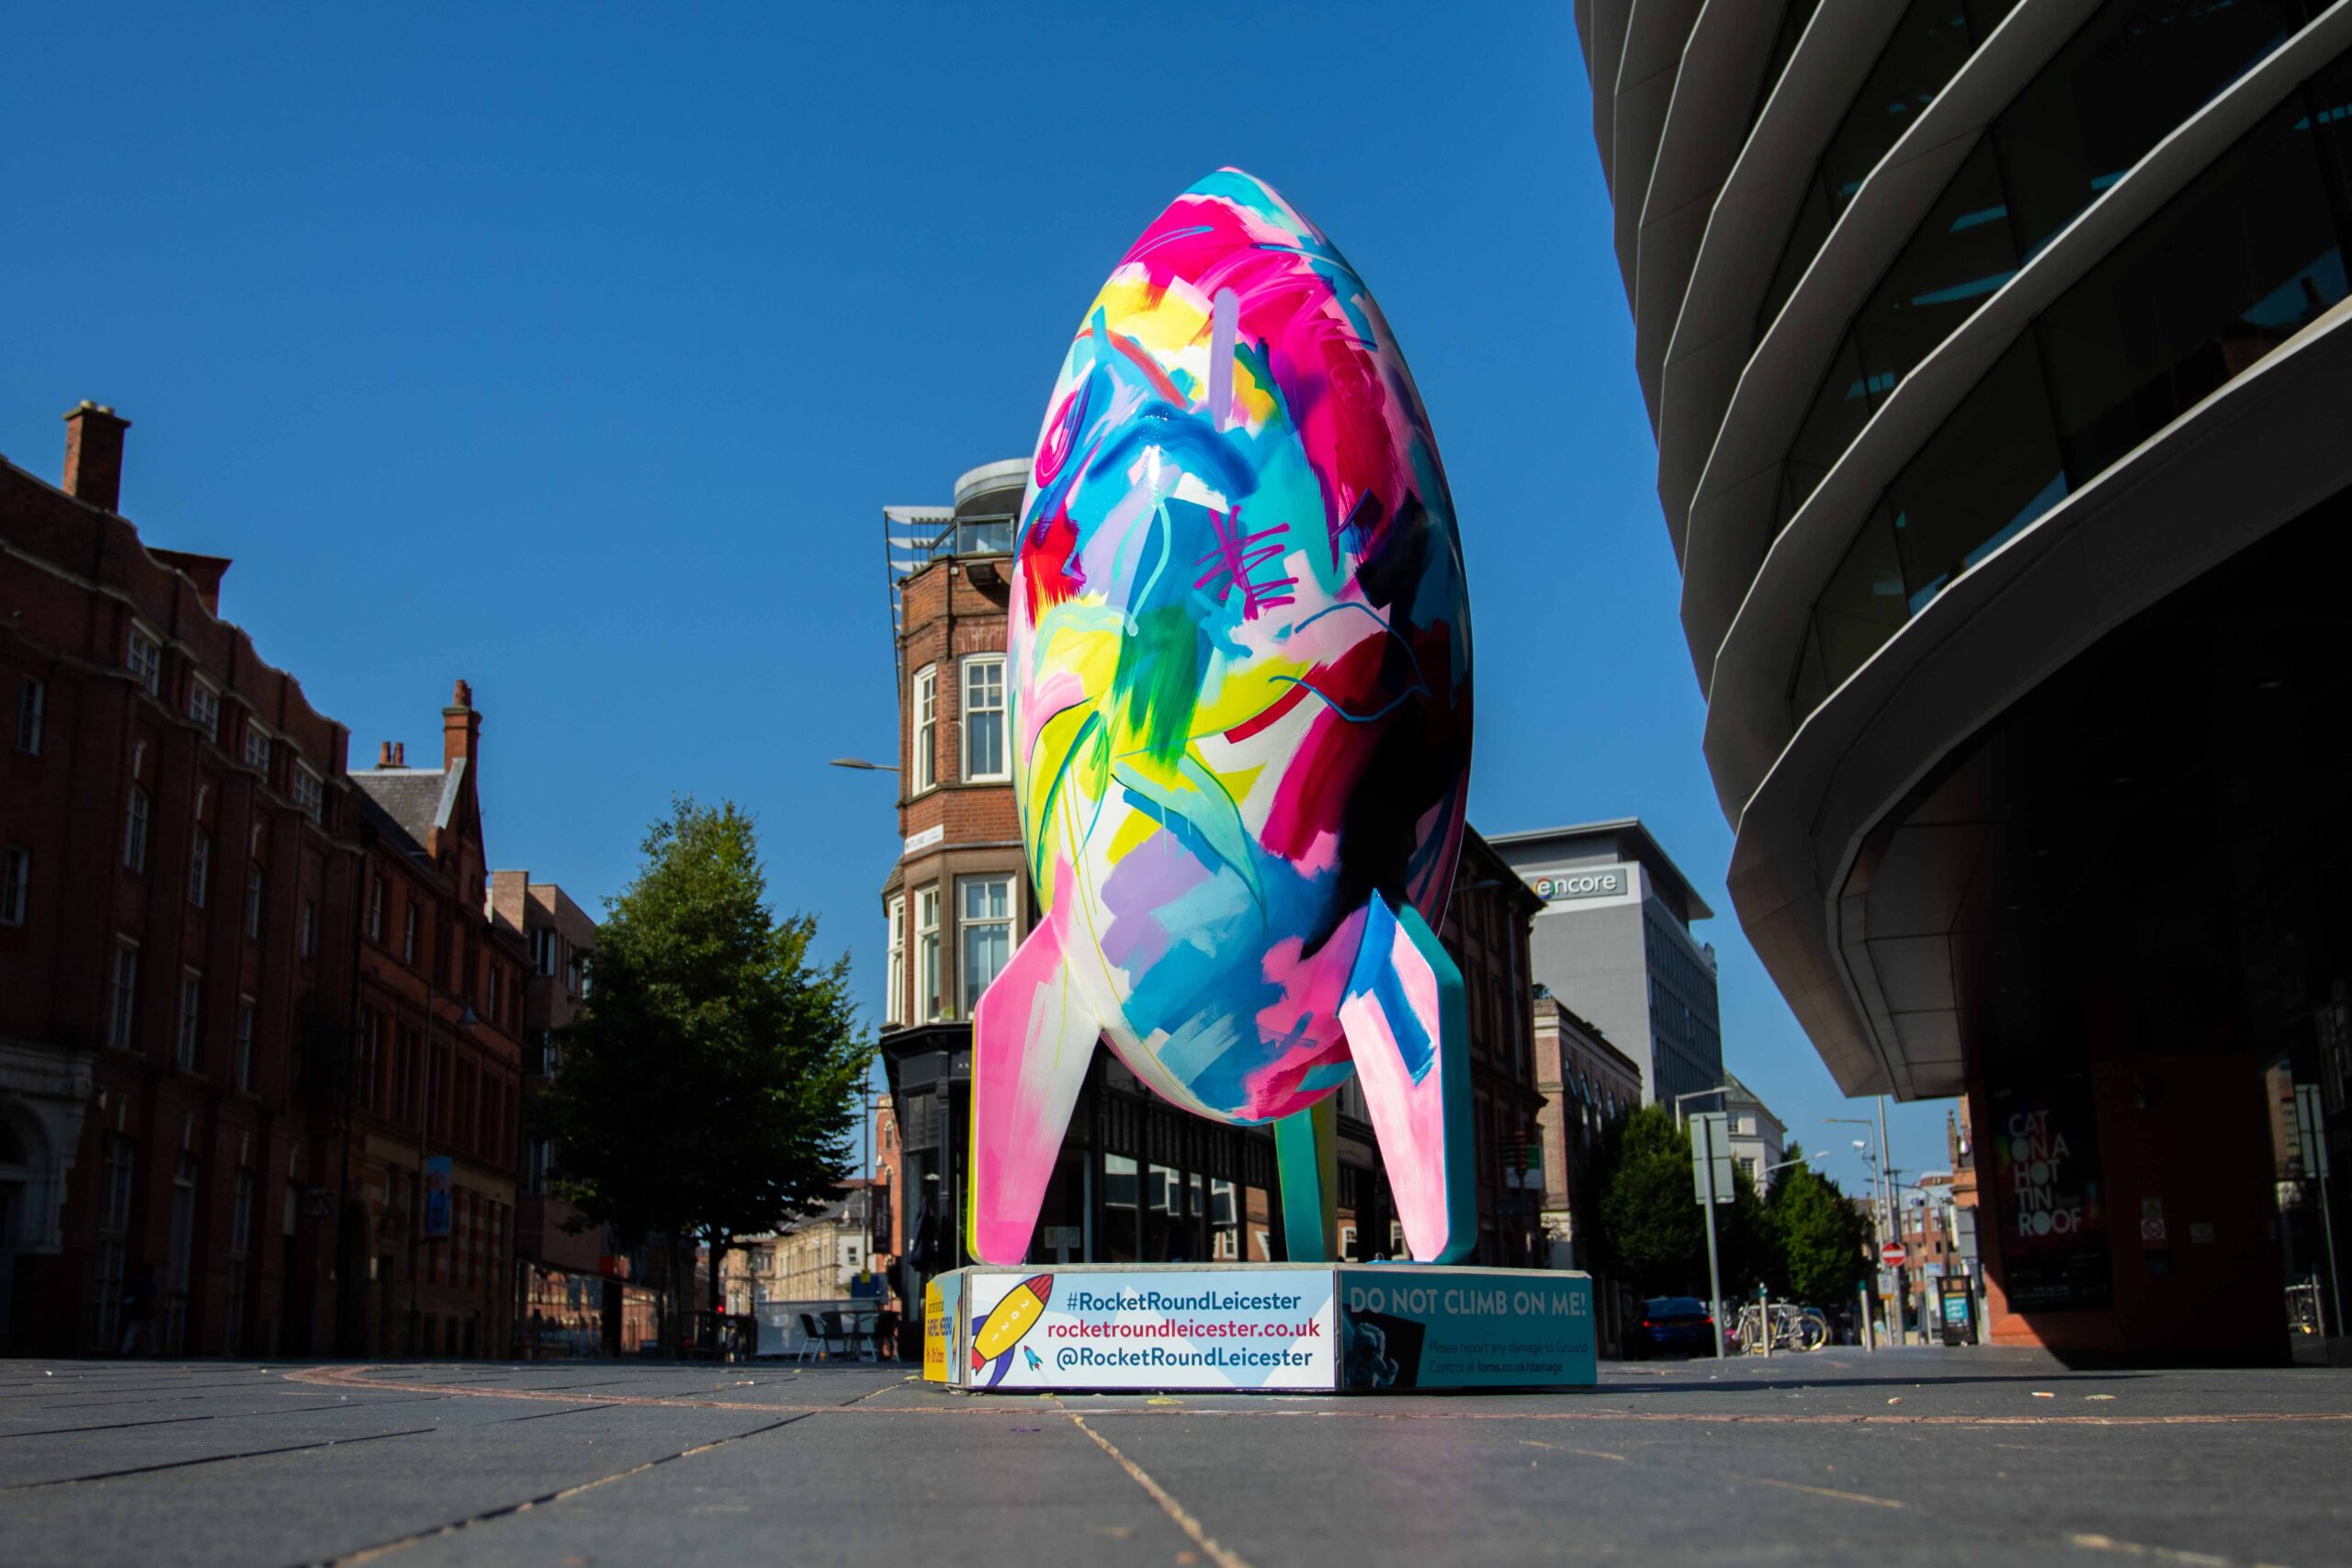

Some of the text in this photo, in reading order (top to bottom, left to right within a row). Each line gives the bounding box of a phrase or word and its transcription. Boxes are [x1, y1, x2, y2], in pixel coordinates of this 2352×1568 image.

[1537, 875, 1617, 895] encore
[2008, 1110, 2050, 1137] CAT
[2011, 1132, 2071, 1161] ON A
[2014, 1159, 2061, 1187] HOT
[2015, 1187, 2052, 1212] TIN
[2018, 1208, 2083, 1236] ROOF
[1068, 1292, 1301, 1311] #RocketRoundLeicester
[1351, 1287, 1587, 1315] DO NOT CLIMB ON ME!
[1048, 1318, 1320, 1338] rocketroundleicester.co.uk
[1057, 1347, 1313, 1370] @RocketRoundLeicester
[1430, 1340, 1588, 1356] Please report any damage to Ground
[1430, 1359, 1563, 1375] Control at loros.co.uk/damage
